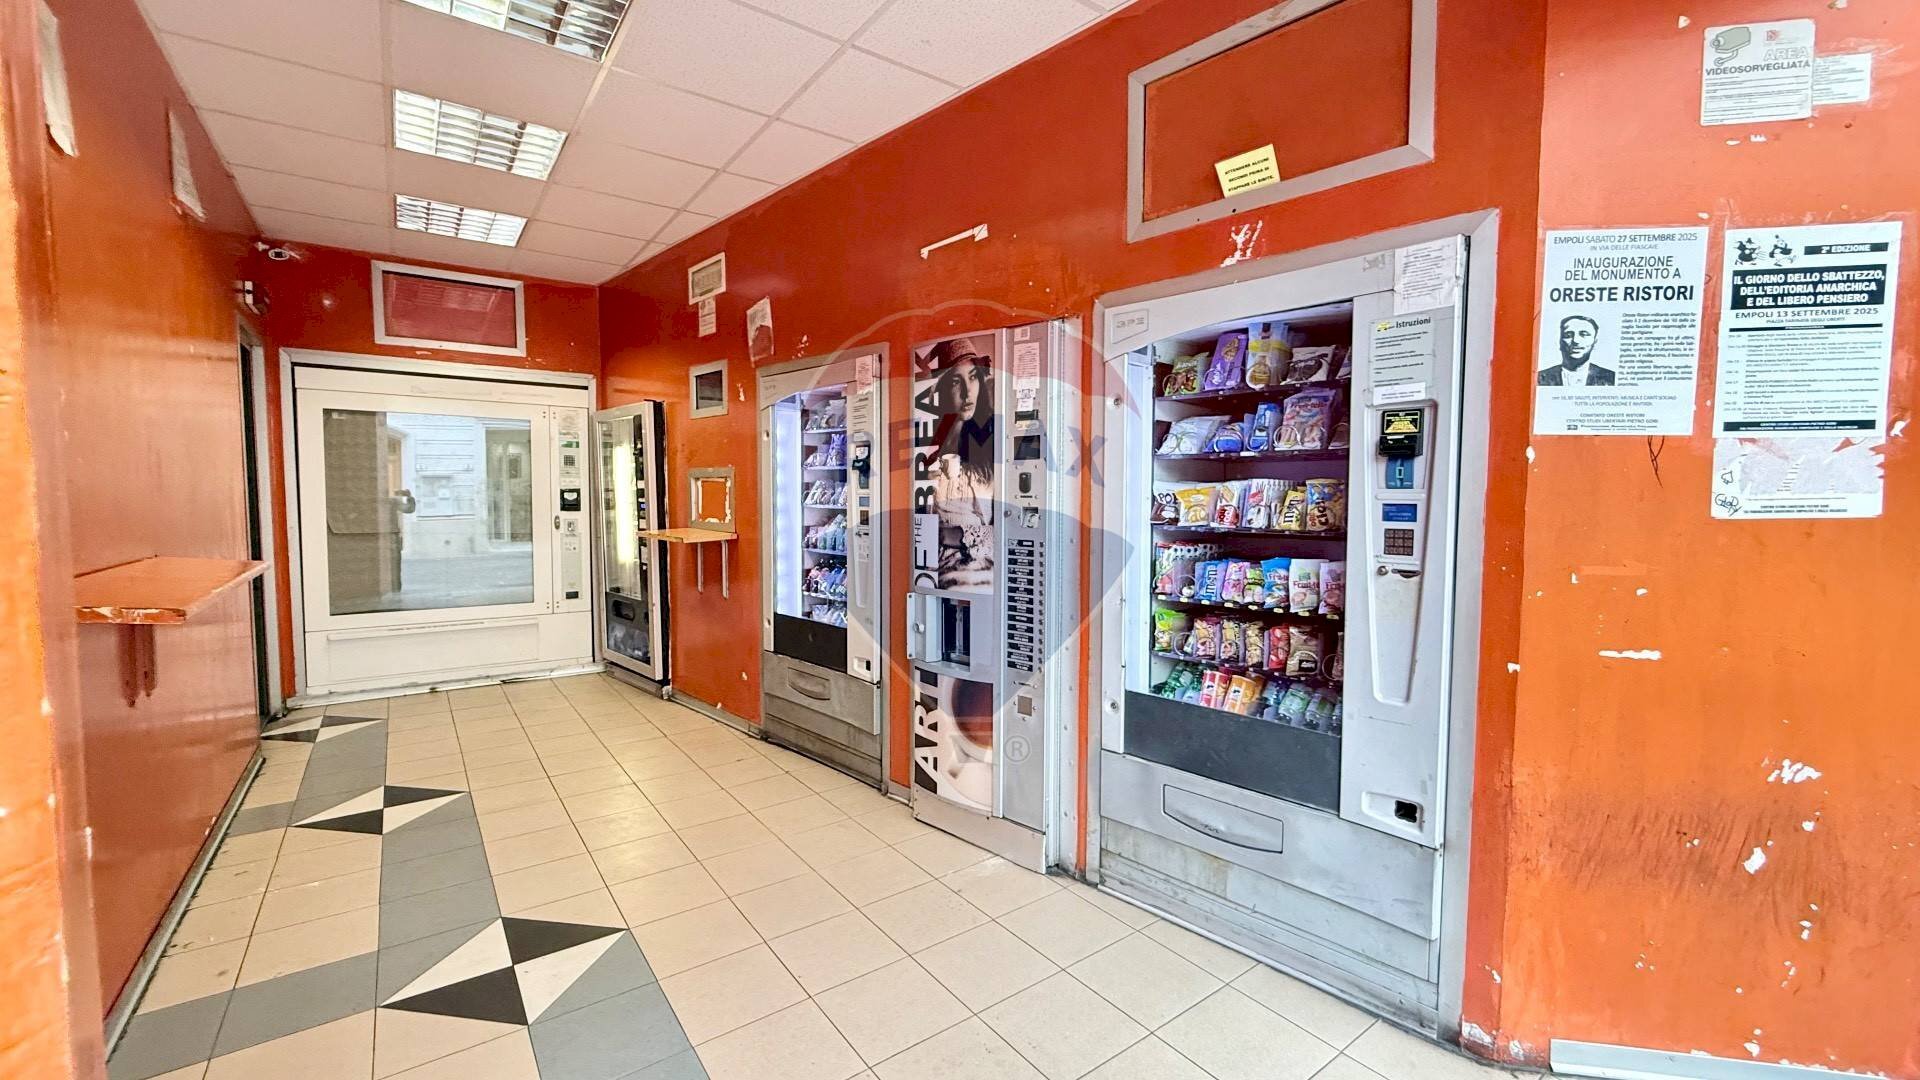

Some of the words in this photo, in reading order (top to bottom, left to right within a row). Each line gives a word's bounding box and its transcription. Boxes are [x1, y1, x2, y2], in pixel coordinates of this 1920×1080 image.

[1763, 46, 1811, 62] AREA
[1705, 59, 1811, 76] VIDEOSORVEGLIATA
[1554, 236, 1584, 244] EMPOLI
[1585, 235, 1616, 243] SABATO
[1617, 235, 1627, 243] 27
[1629, 234, 1676, 242] SETTEMBRE
[1678, 233, 1698, 241] 2025
[1831, 244, 1871, 252] EDIZIONE
[1574, 256, 1674, 268] INAUGURAZIONE
[1565, 270, 1588, 281] DEL
[1591, 268, 1670, 280] MONUMENTO
[1672, 268, 1681, 279] A
[1734, 276, 1743, 285] IL
[1745, 274, 1785, 284] GIORNO
[1787, 272, 1819, 283] DELLO
[1822, 270, 1885, 281] SBATTEZZO,
[1549, 286, 1618, 302] ORESTE
[1623, 285, 1694, 301] RISTORI
[1740, 283, 1814, 296] DELL'EDITORIA
[1816, 281, 1877, 293] ANARCHICA
[1746, 298, 1754, 307] E
[1755, 296, 1775, 306] DEL
[1777, 295, 1814, 305] LIBERO
[1816, 293, 1869, 304] PENSIERO
[1735, 311, 1773, 319] EMPOLI
[1777, 310, 1788, 318] 13
[1791, 308, 1850, 317] SETTEMBRE
[1853, 307, 1879, 315] 2025
[914, 341, 940, 515] BREAK
[914, 517, 923, 545] THE
